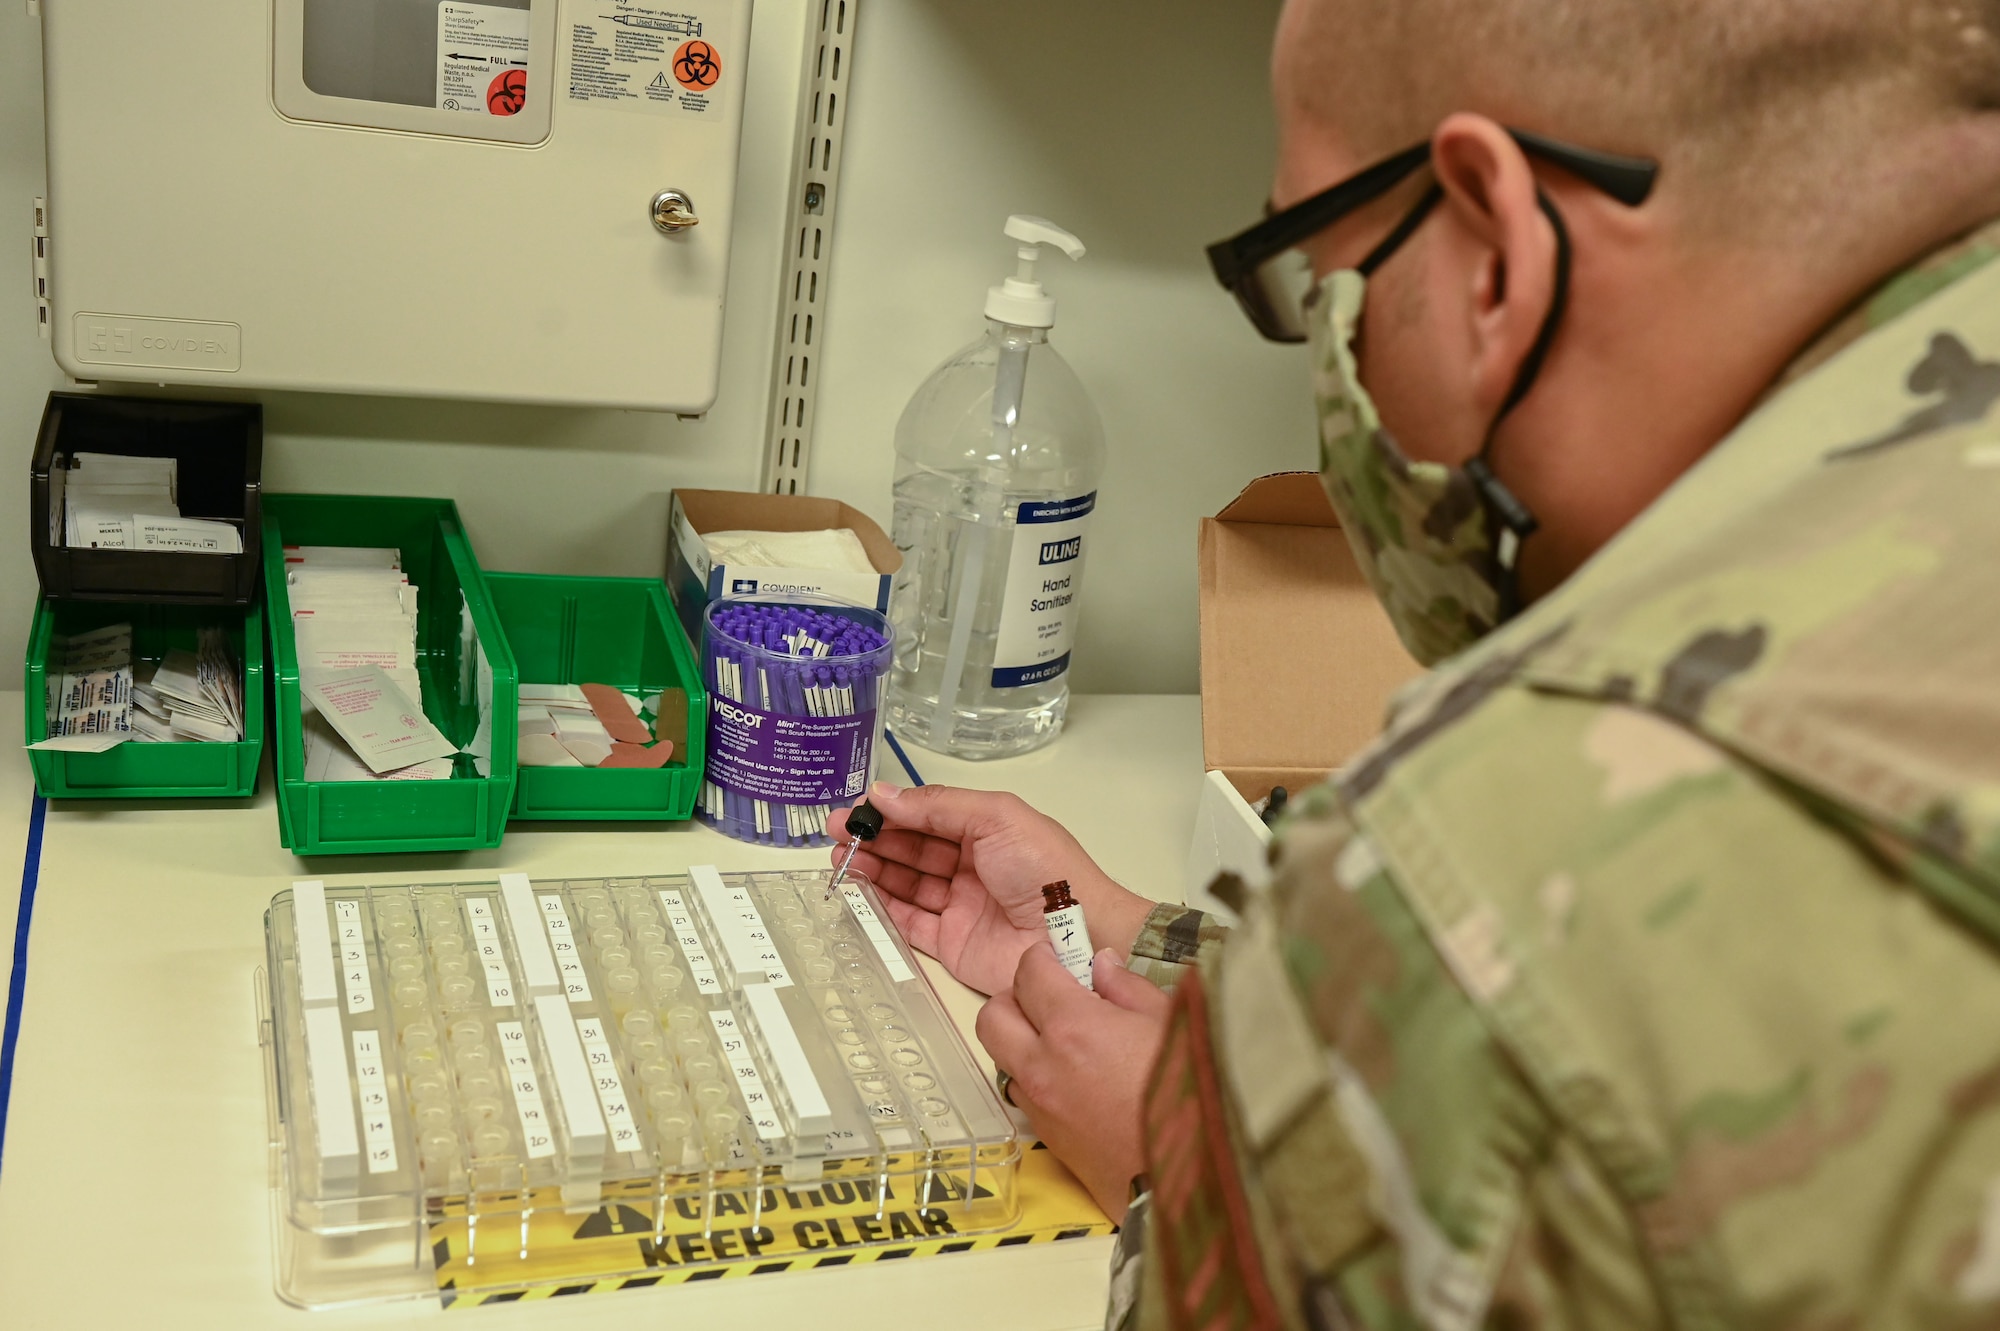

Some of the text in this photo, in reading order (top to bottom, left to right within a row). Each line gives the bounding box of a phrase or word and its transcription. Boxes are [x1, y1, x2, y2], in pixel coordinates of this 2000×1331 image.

[654, 20, 679, 30] Needles
[490, 56, 508, 65] FULL
[444, 62, 470, 70] Regulated
[141, 335, 228, 354] COVIDIEN
[1042, 540, 1080, 562] ULINE
[1042, 575, 1070, 593] Hand
[1030, 592, 1073, 612] Sanitizer
[717, 748, 733, 760] Single
[734, 756, 754, 767] Patient
[769, 766, 785, 774] Only
[747, 772, 771, 782] Degrease
[745, 778, 763, 787] alcohol
[743, 784, 758, 792] before
[759, 788, 781, 797] applying
[1051, 914, 1067, 922] TEST
[478, 924, 489, 932] 7
[550, 920, 565, 928] 22
[345, 929, 356, 938] 2
[483, 946, 494, 955] 8
[348, 952, 360, 960] 3
[351, 973, 362, 981] 4
[495, 988, 508, 997] 10
[568, 984, 583, 994] 25
[353, 994, 365, 1004] 5
[716, 1019, 734, 1028] 36
[505, 1032, 522, 1040] 16
[583, 1029, 597, 1038] 31
[360, 1043, 370, 1051] 11
[724, 1041, 741, 1051] 37
[591, 1053, 609, 1064] 32
[362, 1067, 377, 1076] 12
[737, 1068, 756, 1078] 38
[517, 1082, 534, 1092] 18
[598, 1079, 617, 1090] 33
[366, 1094, 383, 1104] 13
[524, 1111, 539, 1119] 19
[607, 1104, 625, 1116] 34
[758, 1120, 774, 1128] 40
[530, 1136, 548, 1147] 20
[373, 1148, 390, 1160] 15
[638, 1208, 958, 1268] KEEP CLEAR
